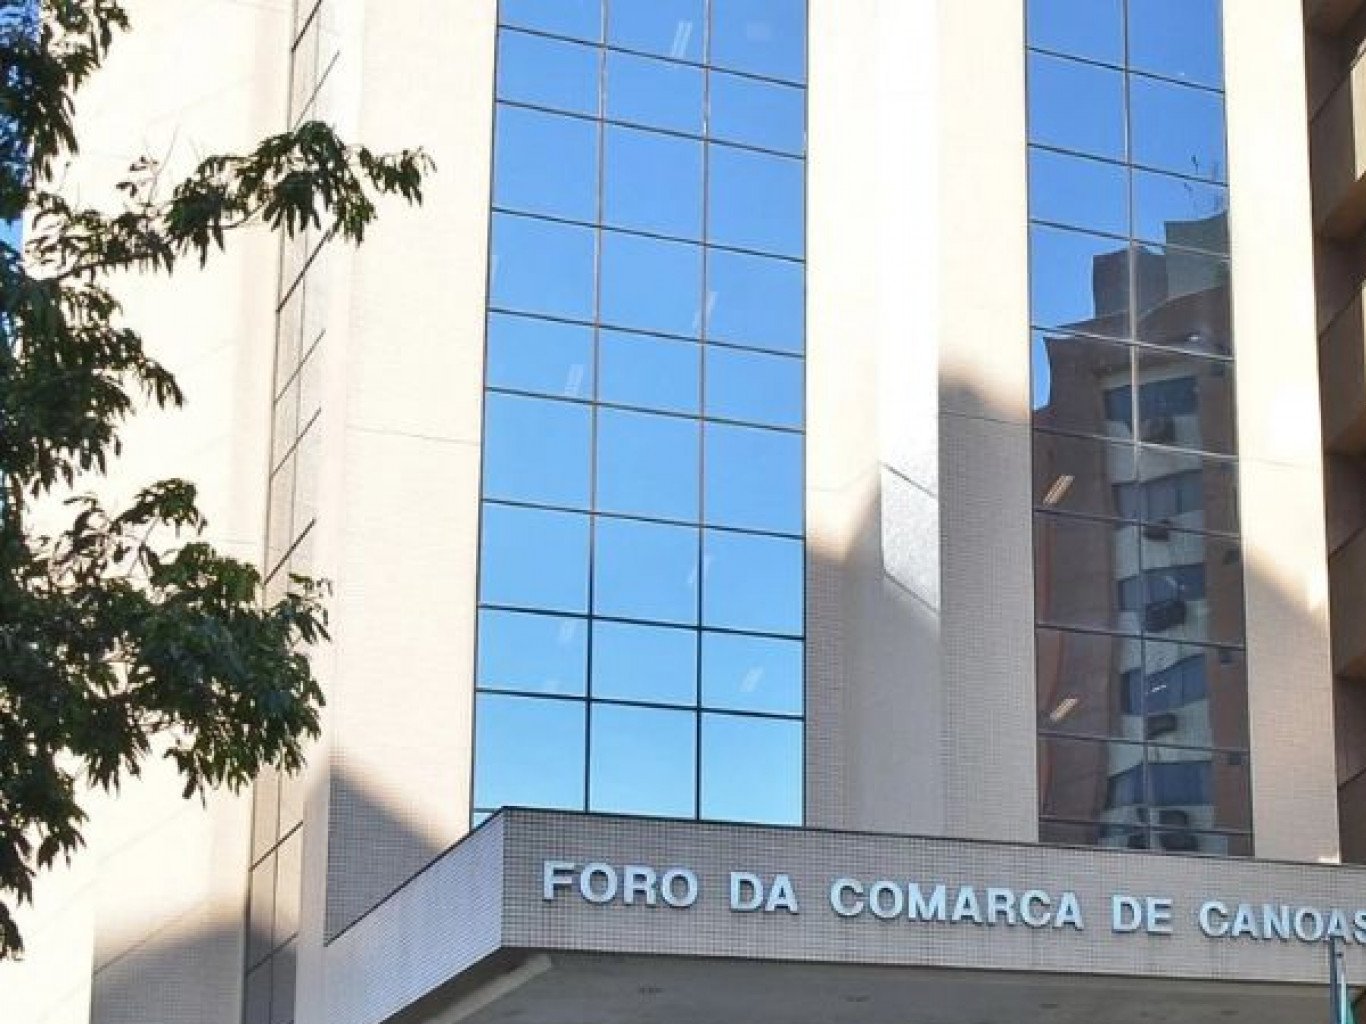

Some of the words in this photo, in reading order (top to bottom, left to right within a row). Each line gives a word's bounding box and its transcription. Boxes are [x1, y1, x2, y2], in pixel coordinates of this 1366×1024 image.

[543, 860, 698, 907] FORO
[729, 871, 799, 913] DA
[830, 878, 1084, 930] COMARCA
[1111, 895, 1173, 934] DE
